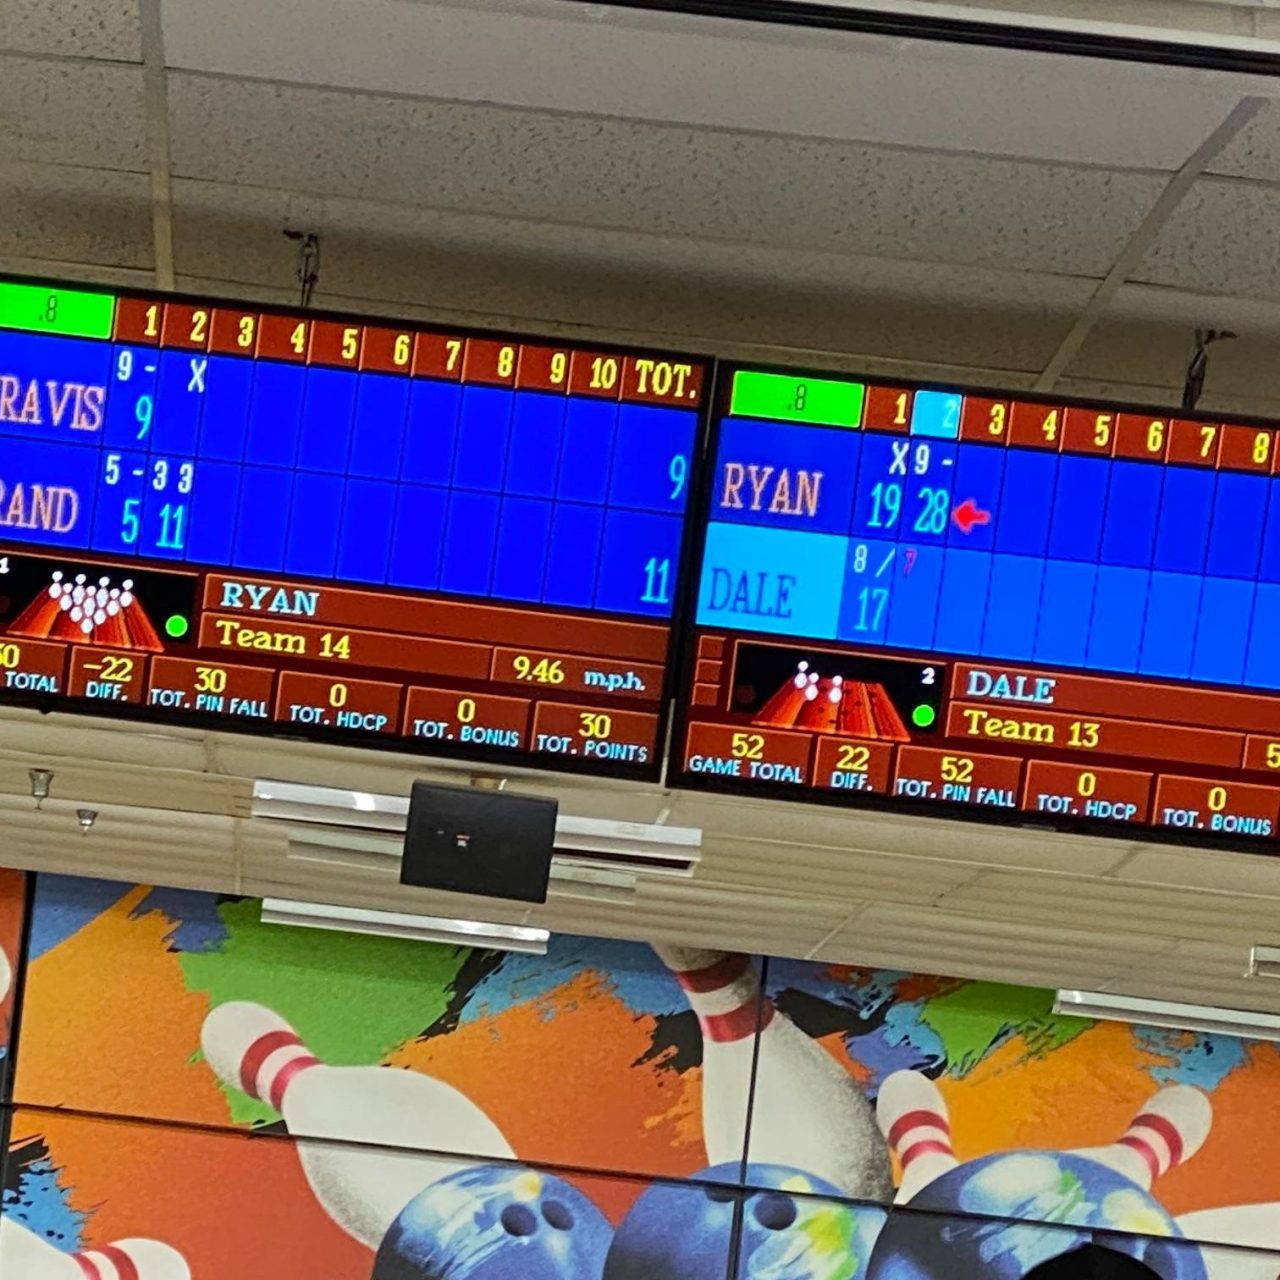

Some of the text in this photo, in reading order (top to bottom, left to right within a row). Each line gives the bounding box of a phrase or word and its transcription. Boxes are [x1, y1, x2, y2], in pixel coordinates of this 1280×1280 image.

[144, 305, 157, 336] 1
[190, 311, 207, 342] 2
[237, 316, 254, 347] 3
[290, 322, 305, 353] 4
[341, 328, 358, 359] 5
[393, 334, 410, 366] 6
[446, 340, 461, 371] 7
[497, 346, 514, 378] 8
[550, 352, 566, 383] 9
[589, 357, 618, 390] 10
[635, 360, 696, 399] TOT.
[187, 359, 207, 393] X
[893, 394, 908, 425] 1
[942, 399, 957, 431] 2
[989, 404, 1005, 436] 3
[1041, 410, 1056, 442] 4
[1094, 415, 1110, 448] 5
[1147, 421, 1163, 453] 6
[1200, 426, 1215, 458] 7
[1252, 432, 1269, 464] 8
[135, 395, 686, 499] 9 9
[720, 462, 823, 517] RYAN
[867, 482, 950, 535] 19 28
[121, 499, 670, 604] 5 11 11
[220, 581, 319, 617] RYAN
[707, 568, 796, 619] DALE
[854, 588, 889, 632] 17
[217, 619, 351, 660] Team 14
[82, 655, 133, 682] -22
[194, 666, 226, 693] 30
[513, 656, 646, 692] 9.46 m.p.h.
[921, 667, 935, 685] 2
[5, 672, 59, 694] TOTAL
[86, 681, 128, 701] DIFF.
[329, 683, 347, 708] 0
[966, 670, 1056, 704] DALE
[150, 688, 268, 718] TOT. PIN FALL
[457, 699, 475, 724] 0
[290, 704, 387, 732] TOT. HDCP
[579, 713, 612, 739] 30
[964, 709, 1054, 743] Team
[1068, 721, 1100, 748] 13
[414, 719, 519, 748] TOT. BONUS
[731, 732, 765, 760] 52
[537, 734, 648, 762] TOT. POINTS
[837, 745, 870, 772] 22
[689, 754, 803, 785] GAME TOTAL
[830, 770, 873, 792] DIFF.
[941, 756, 974, 784] 52
[896, 777, 1016, 808] TOT. PIN FALL
[1077, 772, 1096, 797] 0
[1037, 794, 1137, 821] TOT. HDCP
[1208, 787, 1227, 811] 0
[1163, 808, 1272, 836] TOT. BONUS
